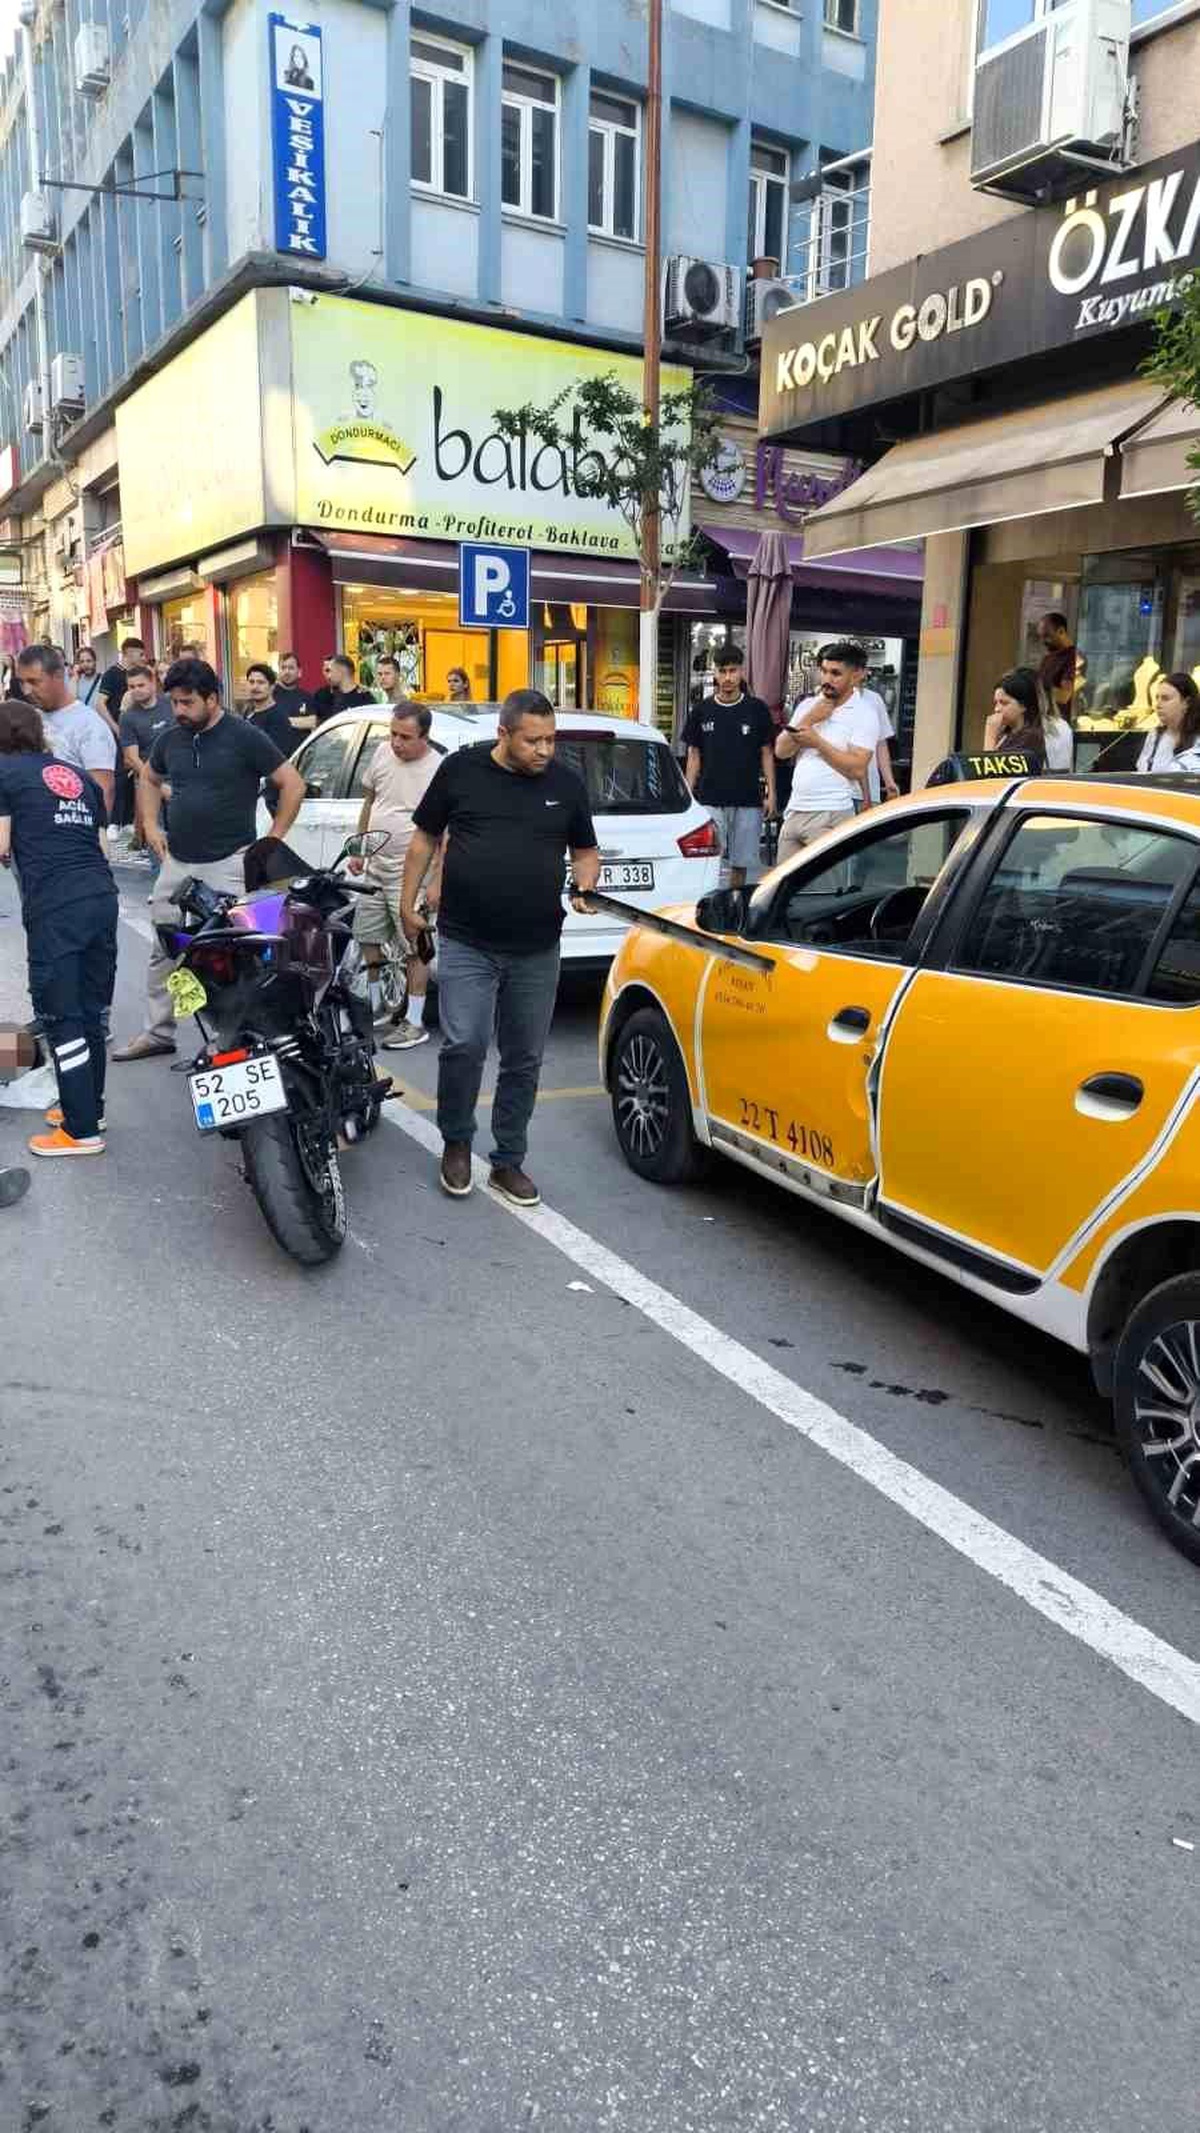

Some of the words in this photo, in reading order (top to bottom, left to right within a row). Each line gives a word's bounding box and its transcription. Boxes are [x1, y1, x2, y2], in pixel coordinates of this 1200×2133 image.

[777, 316, 881, 393] KOÇAK
[890, 278, 992, 350] GOLD
[318, 500, 428, 529] Dondurma
[475, 554, 510, 617] P
[623, 866, 649, 883] 338
[195, 1074, 224, 1097] 52
[245, 1060, 275, 1084] SE
[217, 1089, 261, 1117] 205
[740, 1098, 760, 1130] 22
[764, 1108, 779, 1140] T
[787, 1120, 834, 1168] 4108
